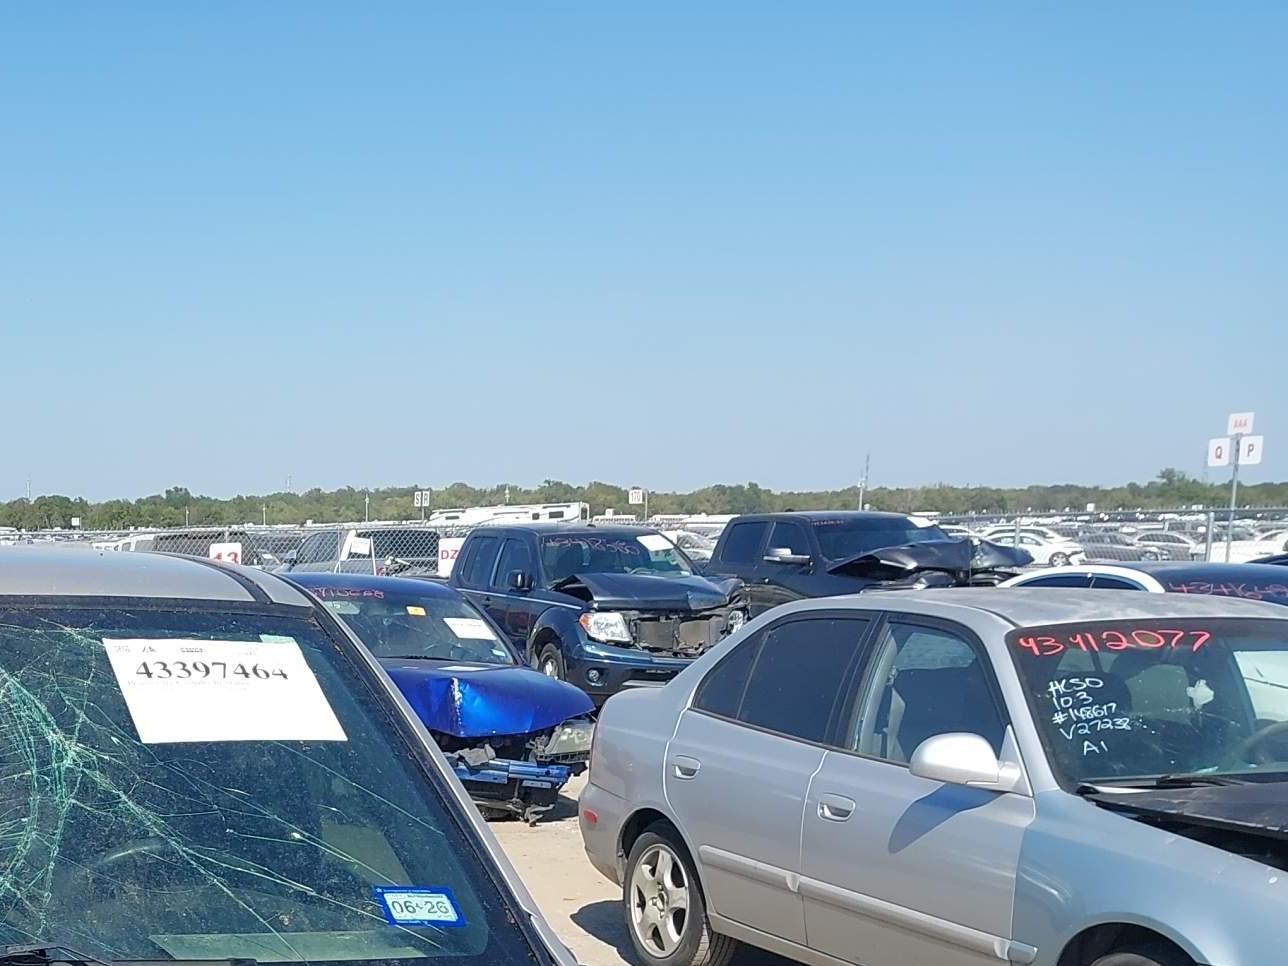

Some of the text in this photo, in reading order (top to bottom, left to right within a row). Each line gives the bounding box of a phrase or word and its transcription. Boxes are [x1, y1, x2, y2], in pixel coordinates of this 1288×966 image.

[1215, 446, 1223, 460] Q
[1247, 443, 1255, 457] P
[1019, 629, 1210, 656] 43412077
[135, 660, 289, 680] 43397464
[391, 900, 450, 914] 06 26
